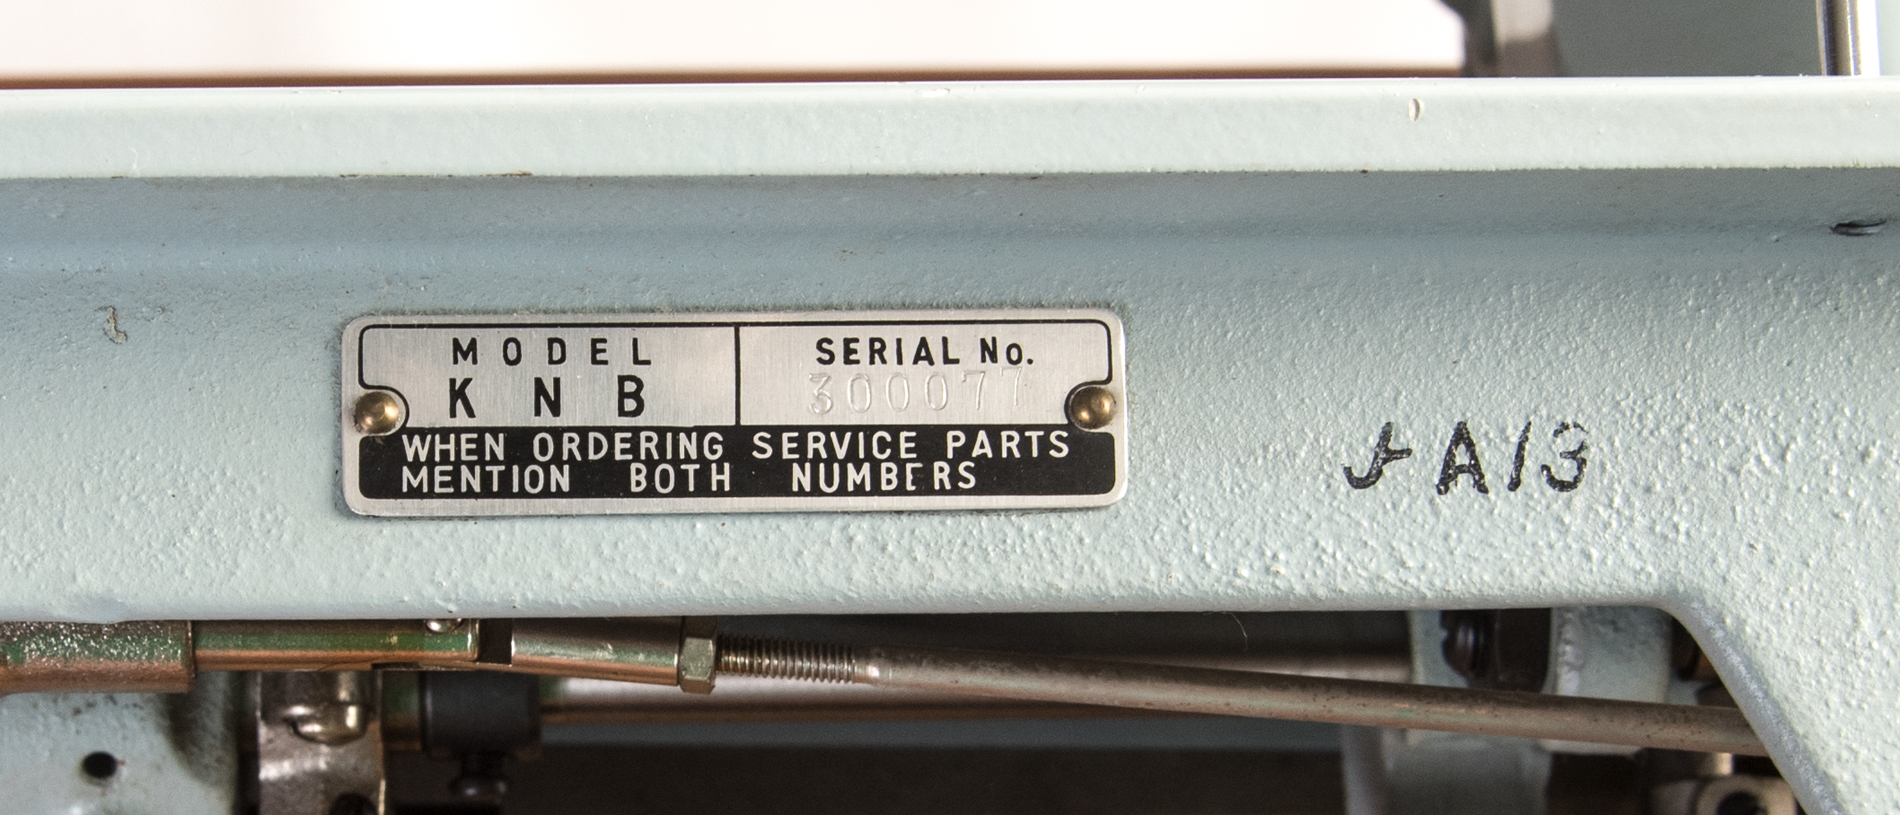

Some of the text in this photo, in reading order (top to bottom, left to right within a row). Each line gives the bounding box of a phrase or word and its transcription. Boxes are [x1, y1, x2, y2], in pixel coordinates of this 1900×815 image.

[453, 337, 651, 366] MODEL
[816, 337, 1033, 366] SERIAL No.
[809, 368, 1022, 414] 300077
[402, 430, 1069, 461] WHEN ORDERING SERVICE PARTS
[403, 462, 977, 493] MENTION BOTH NUMBERS
